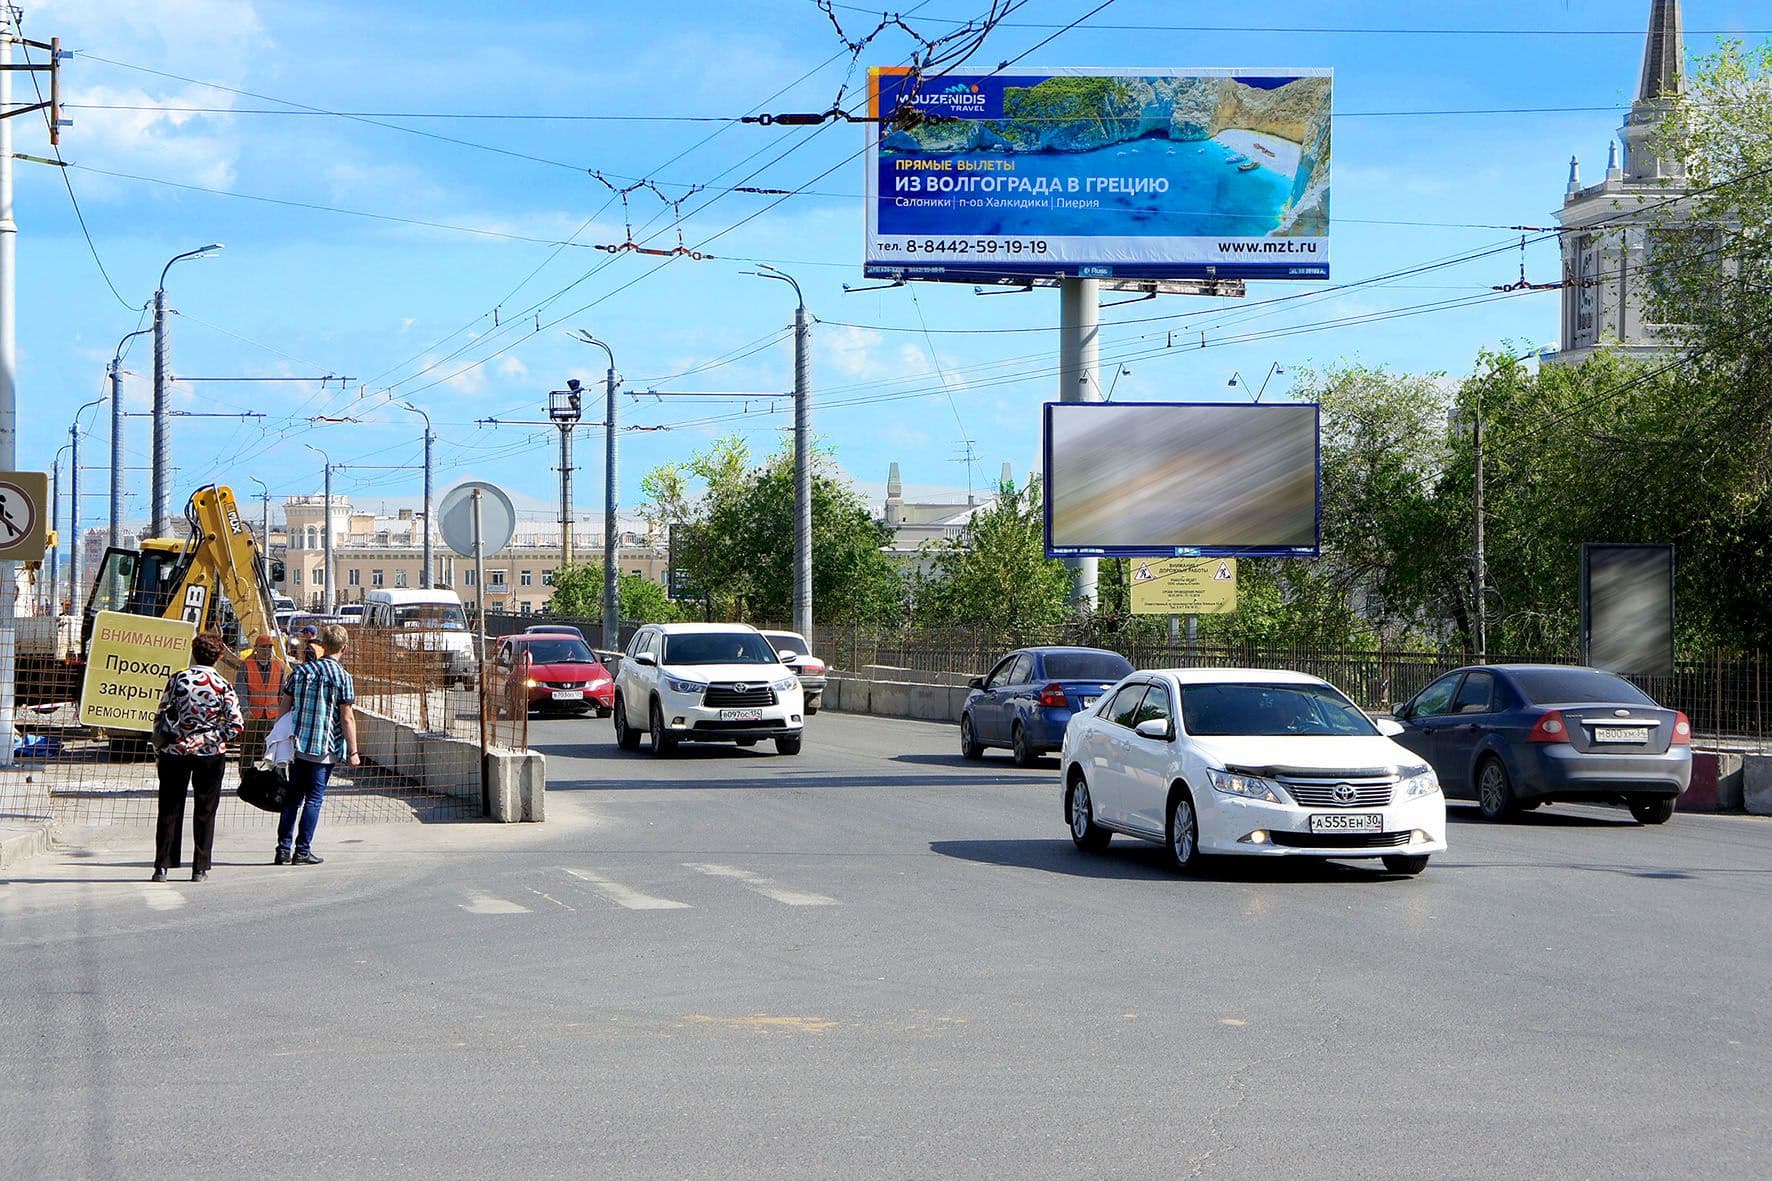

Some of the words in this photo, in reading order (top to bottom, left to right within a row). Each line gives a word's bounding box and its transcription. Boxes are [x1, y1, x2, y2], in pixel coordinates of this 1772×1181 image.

[896, 94, 986, 104] MOUZENIDIS
[895, 160, 953, 170] ПРЯМЫЕ
[957, 160, 1015, 171] ВЫЛЕТЫ
[895, 176, 921, 192] ИЗ
[927, 176, 1063, 195] ВОЛГОГРАДА
[1067, 177, 1080, 192] В
[1086, 177, 1169, 196] ГРЕЦИЮ
[895, 196, 951, 207] Салоники
[959, 198, 984, 207] п-ов
[985, 197, 1048, 209] Халкидики
[1056, 197, 1100, 209] Пиерия
[877, 242, 902, 251] тел.
[906, 239, 1048, 254] 8-8442-59-19-19
[1218, 240, 1317, 253] www.mzt.ru
[101, 628, 187, 650] ВНИМАНИЕ!
[106, 654, 171, 678] Проход
[99, 682, 164, 700] закрыт
[87, 705, 137, 720] РЕМОНТ
[1366, 815, 1378, 825] 30
